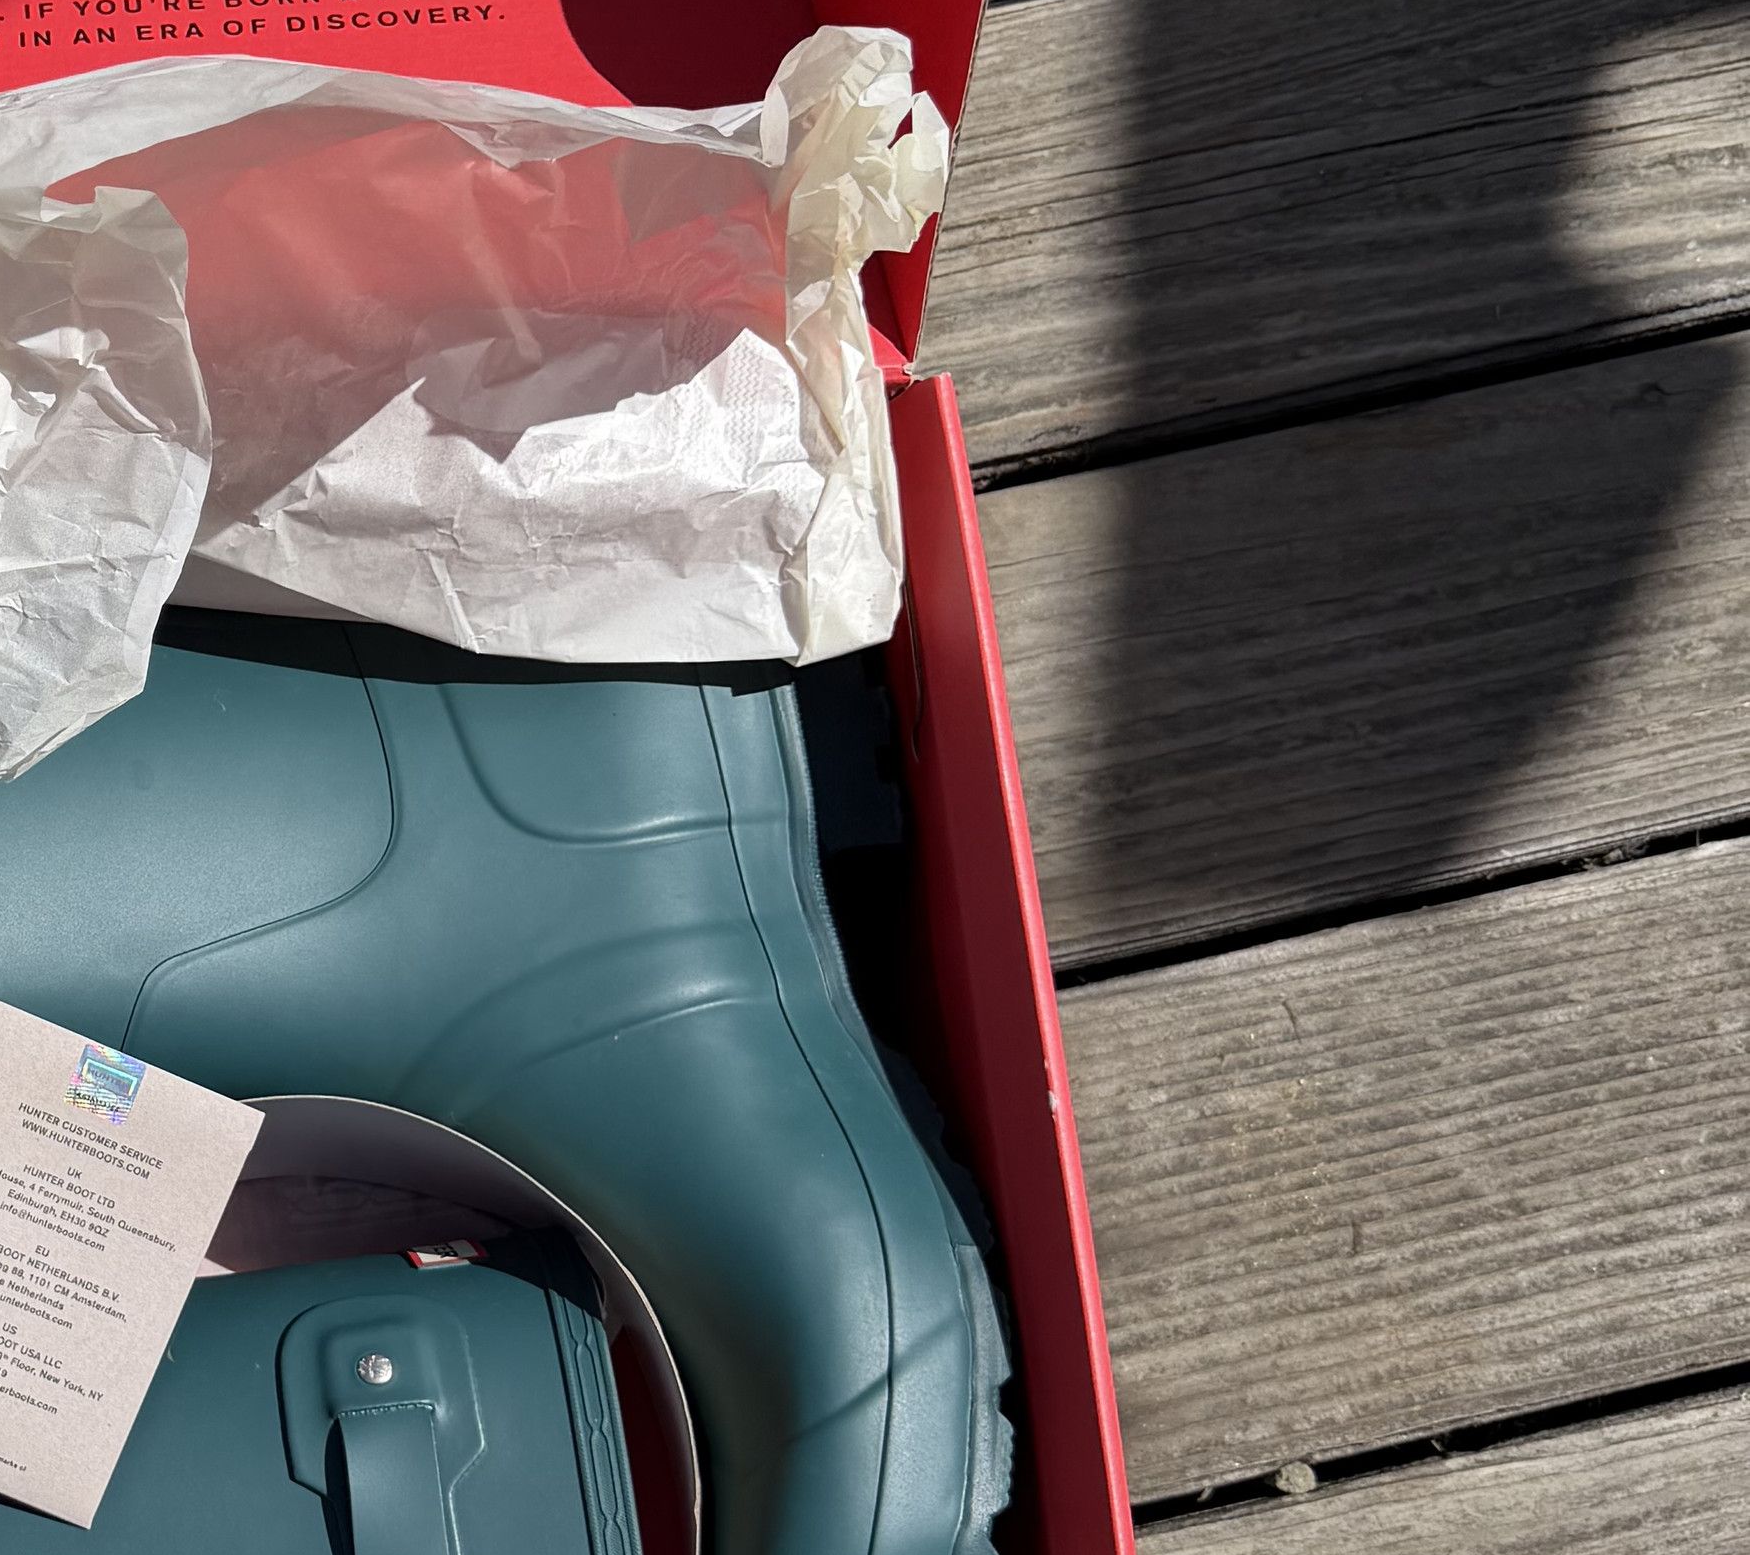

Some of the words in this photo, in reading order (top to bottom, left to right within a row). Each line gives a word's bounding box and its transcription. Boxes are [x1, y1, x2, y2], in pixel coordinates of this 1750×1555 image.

[20, 31, 52, 48] IN
[73, 28, 116, 45] AN
[136, 23, 204, 41] ERA
[223, 19, 266, 36] OF
[287, 5, 505, 32] DISCOVERY.
[25, 3, 53, 20] IF
[17, 1102, 61, 1127] HUNTER
[61, 1120, 119, 1151] CUSTOMER
[118, 1144, 164, 1170] SERVICE
[21, 1118, 151, 1180] WWW.HUNTERBOOTS.COM
[22, 1164, 65, 1189] HUNTER
[65, 1181, 97, 1201] BOOT
[96, 1194, 116, 1210] LTD
[66, 1166, 83, 1180] UK
[7, 1188, 58, 1218] Edinburgh,
[59, 1209, 87, 1229] EH30
[28, 1183, 37, 1192] 4
[86, 1206, 116, 1226] South
[34, 1244, 51, 1258] EU
[6, 1279, 65, 1311] Netherlands
[26, 1256, 100, 1295] NETHERLANDS
[28, 1273, 51, 1290] 1101
[53, 1283, 71, 1298] CM
[70, 1291, 127, 1324] Amsterdam,
[1, 1322, 18, 1336] US
[19, 1344, 41, 1362] USA
[42, 1354, 63, 1370] LLC
[9, 1356, 37, 1377] Floor,
[38, 1368, 61, 1385] New
[63, 1378, 86, 1397] York,
[87, 1389, 104, 1402] NY
